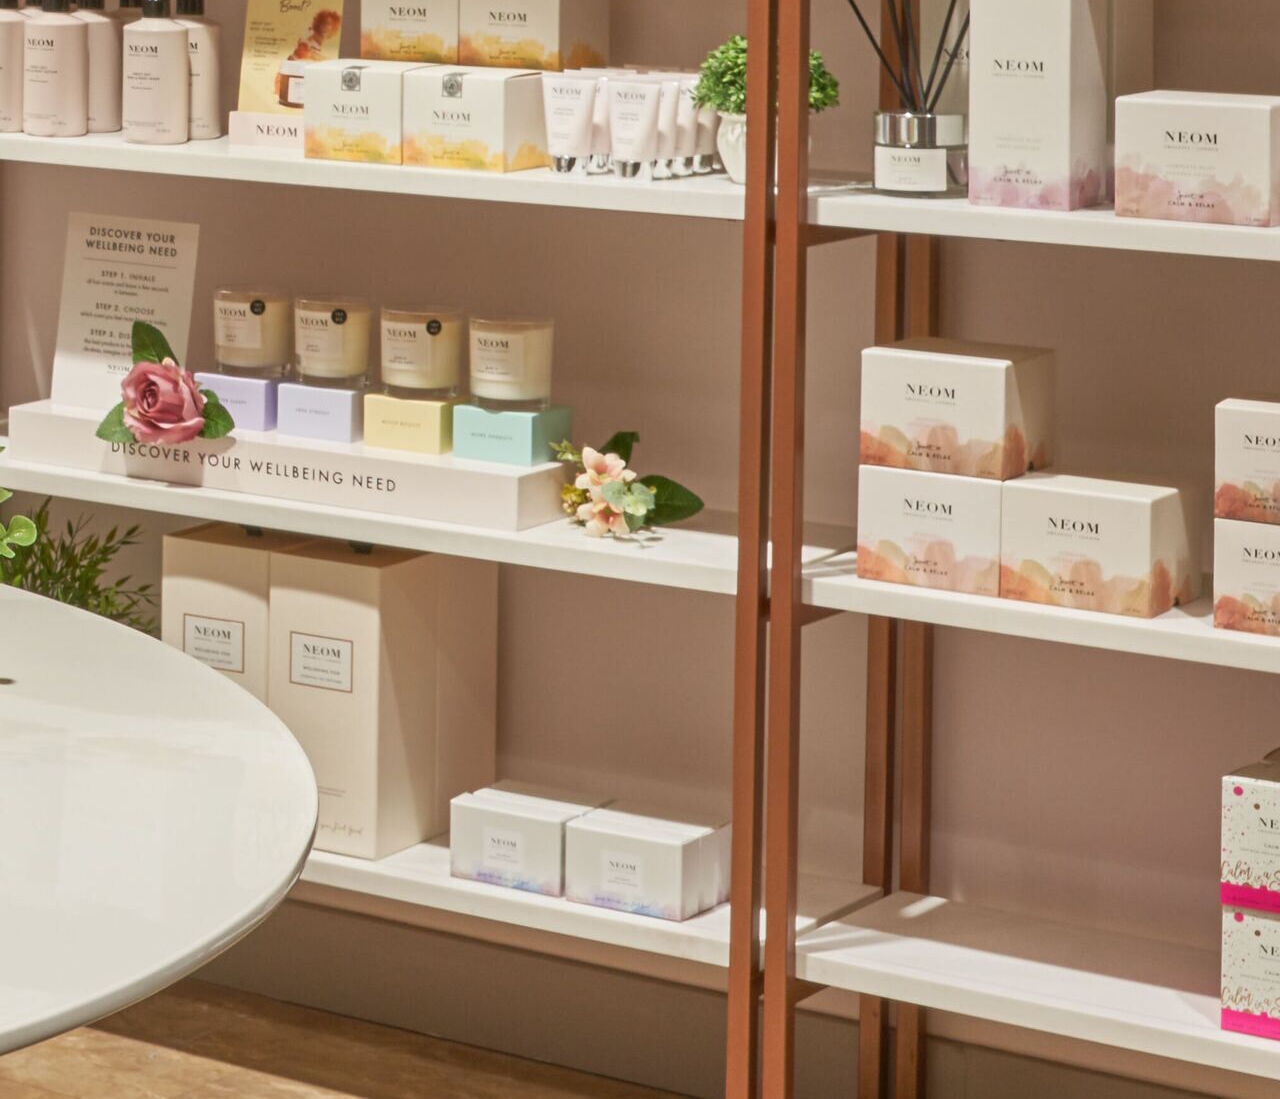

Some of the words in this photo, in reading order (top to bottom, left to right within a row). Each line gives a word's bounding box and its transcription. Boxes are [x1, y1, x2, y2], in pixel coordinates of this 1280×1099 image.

[389, 6, 427, 18] NEOM
[489, 11, 527, 23] NEOM
[993, 59, 1044, 72] NEOM
[332, 103, 369, 115] NEOM
[256, 124, 298, 137] NEOM
[1164, 130, 1218, 145] NEOM
[90, 227, 141, 240] DISCOVER
[147, 233, 176, 244] YOUR
[86, 239, 145, 254] WELLBEING
[149, 246, 178, 258] NEED
[907, 383, 956, 400] NEOM
[111, 442, 190, 463] DISCOVER
[197, 454, 241, 470] YOUR
[249, 460, 344, 484] WELLBEING
[352, 474, 397, 492] NEED
[904, 498, 953, 515] NEOM
[1048, 517, 1100, 534] NEOM
[194, 625, 231, 640] NEOM
[303, 644, 341, 658] NEOM
